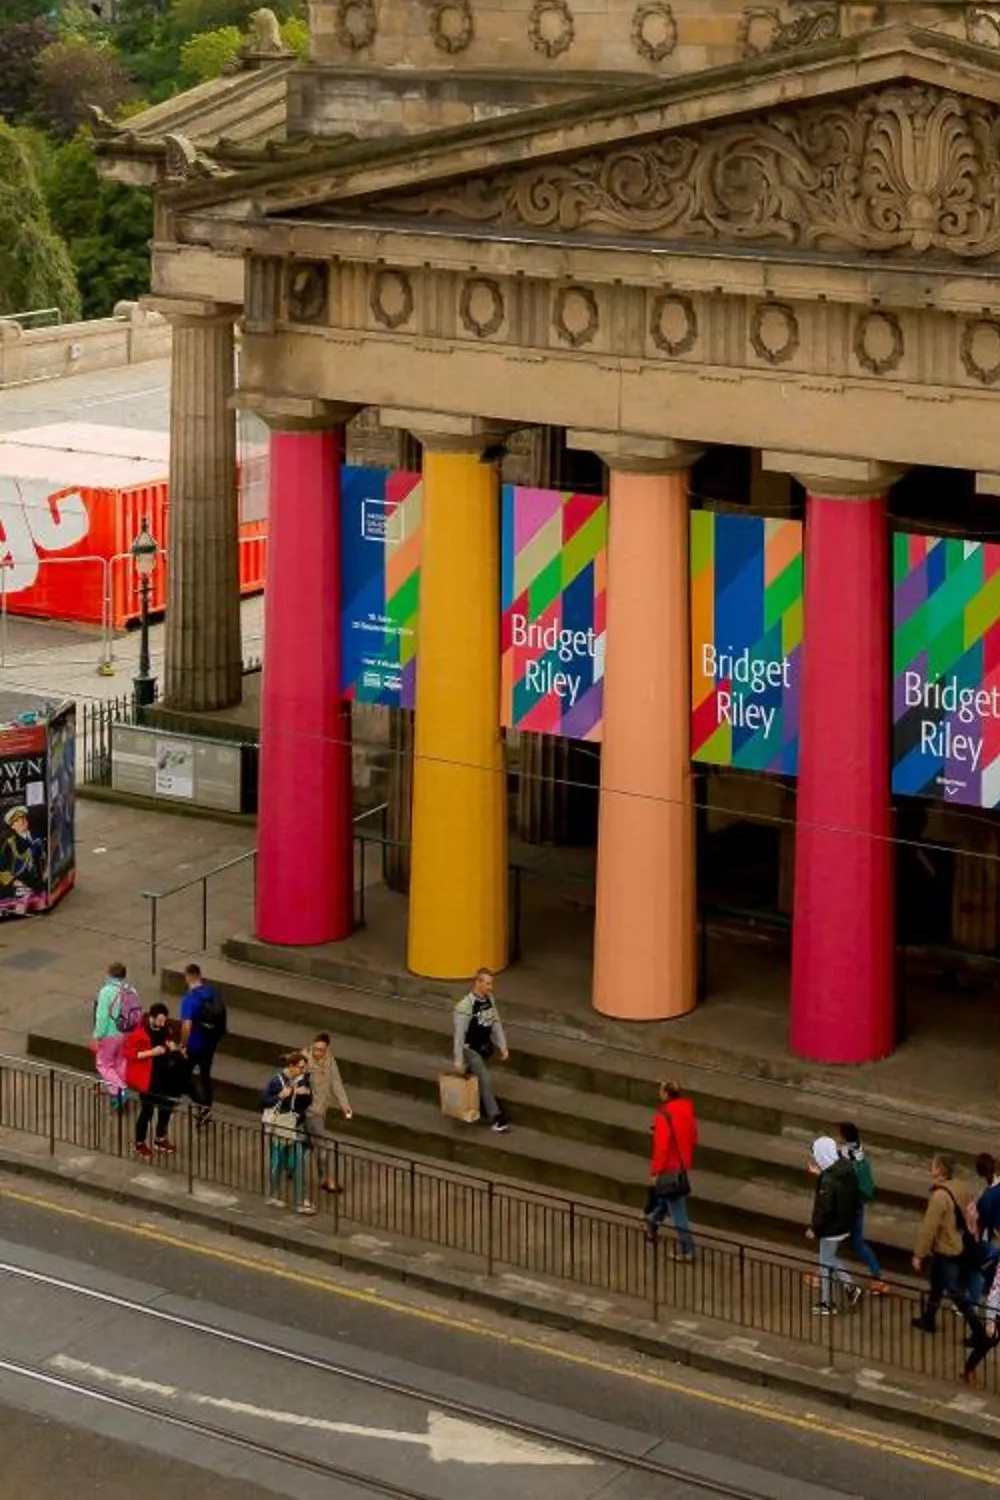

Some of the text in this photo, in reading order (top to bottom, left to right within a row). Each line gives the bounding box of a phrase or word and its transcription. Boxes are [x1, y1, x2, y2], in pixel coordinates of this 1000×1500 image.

[512, 613, 597, 662] Bridget
[525, 660, 581, 705] Riley
[702, 643, 790, 693] Bridget
[716, 691, 775, 738] Riley
[904, 671, 1000, 723] Bridget
[921, 721, 984, 771] Riley
